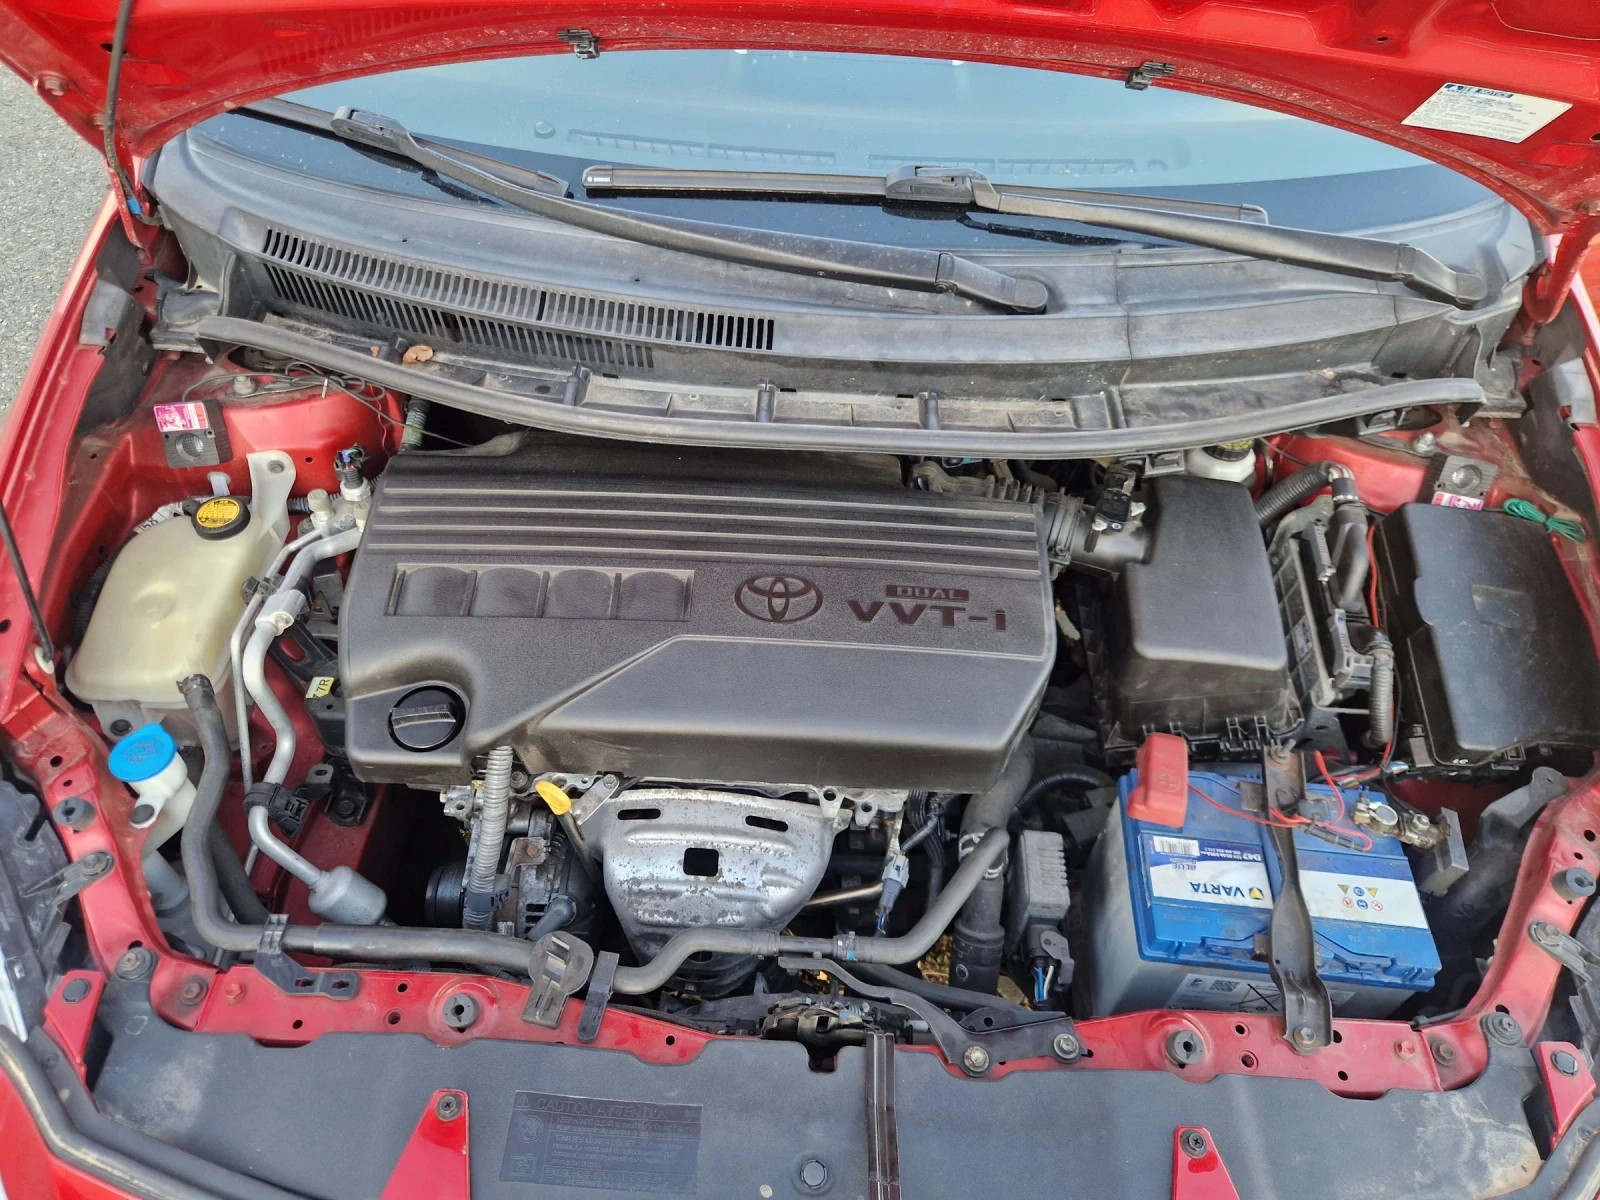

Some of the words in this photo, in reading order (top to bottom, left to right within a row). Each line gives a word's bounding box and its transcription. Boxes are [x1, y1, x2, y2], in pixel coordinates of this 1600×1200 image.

[896, 586, 956, 600] DUAL
[849, 600, 1006, 631] VVT-i
[1172, 862, 1197, 871] BLUE
[1189, 881, 1245, 898] VARTA
[535, 1097, 593, 1114] CAUTION
[596, 1102, 668, 1120] ATTENTION
